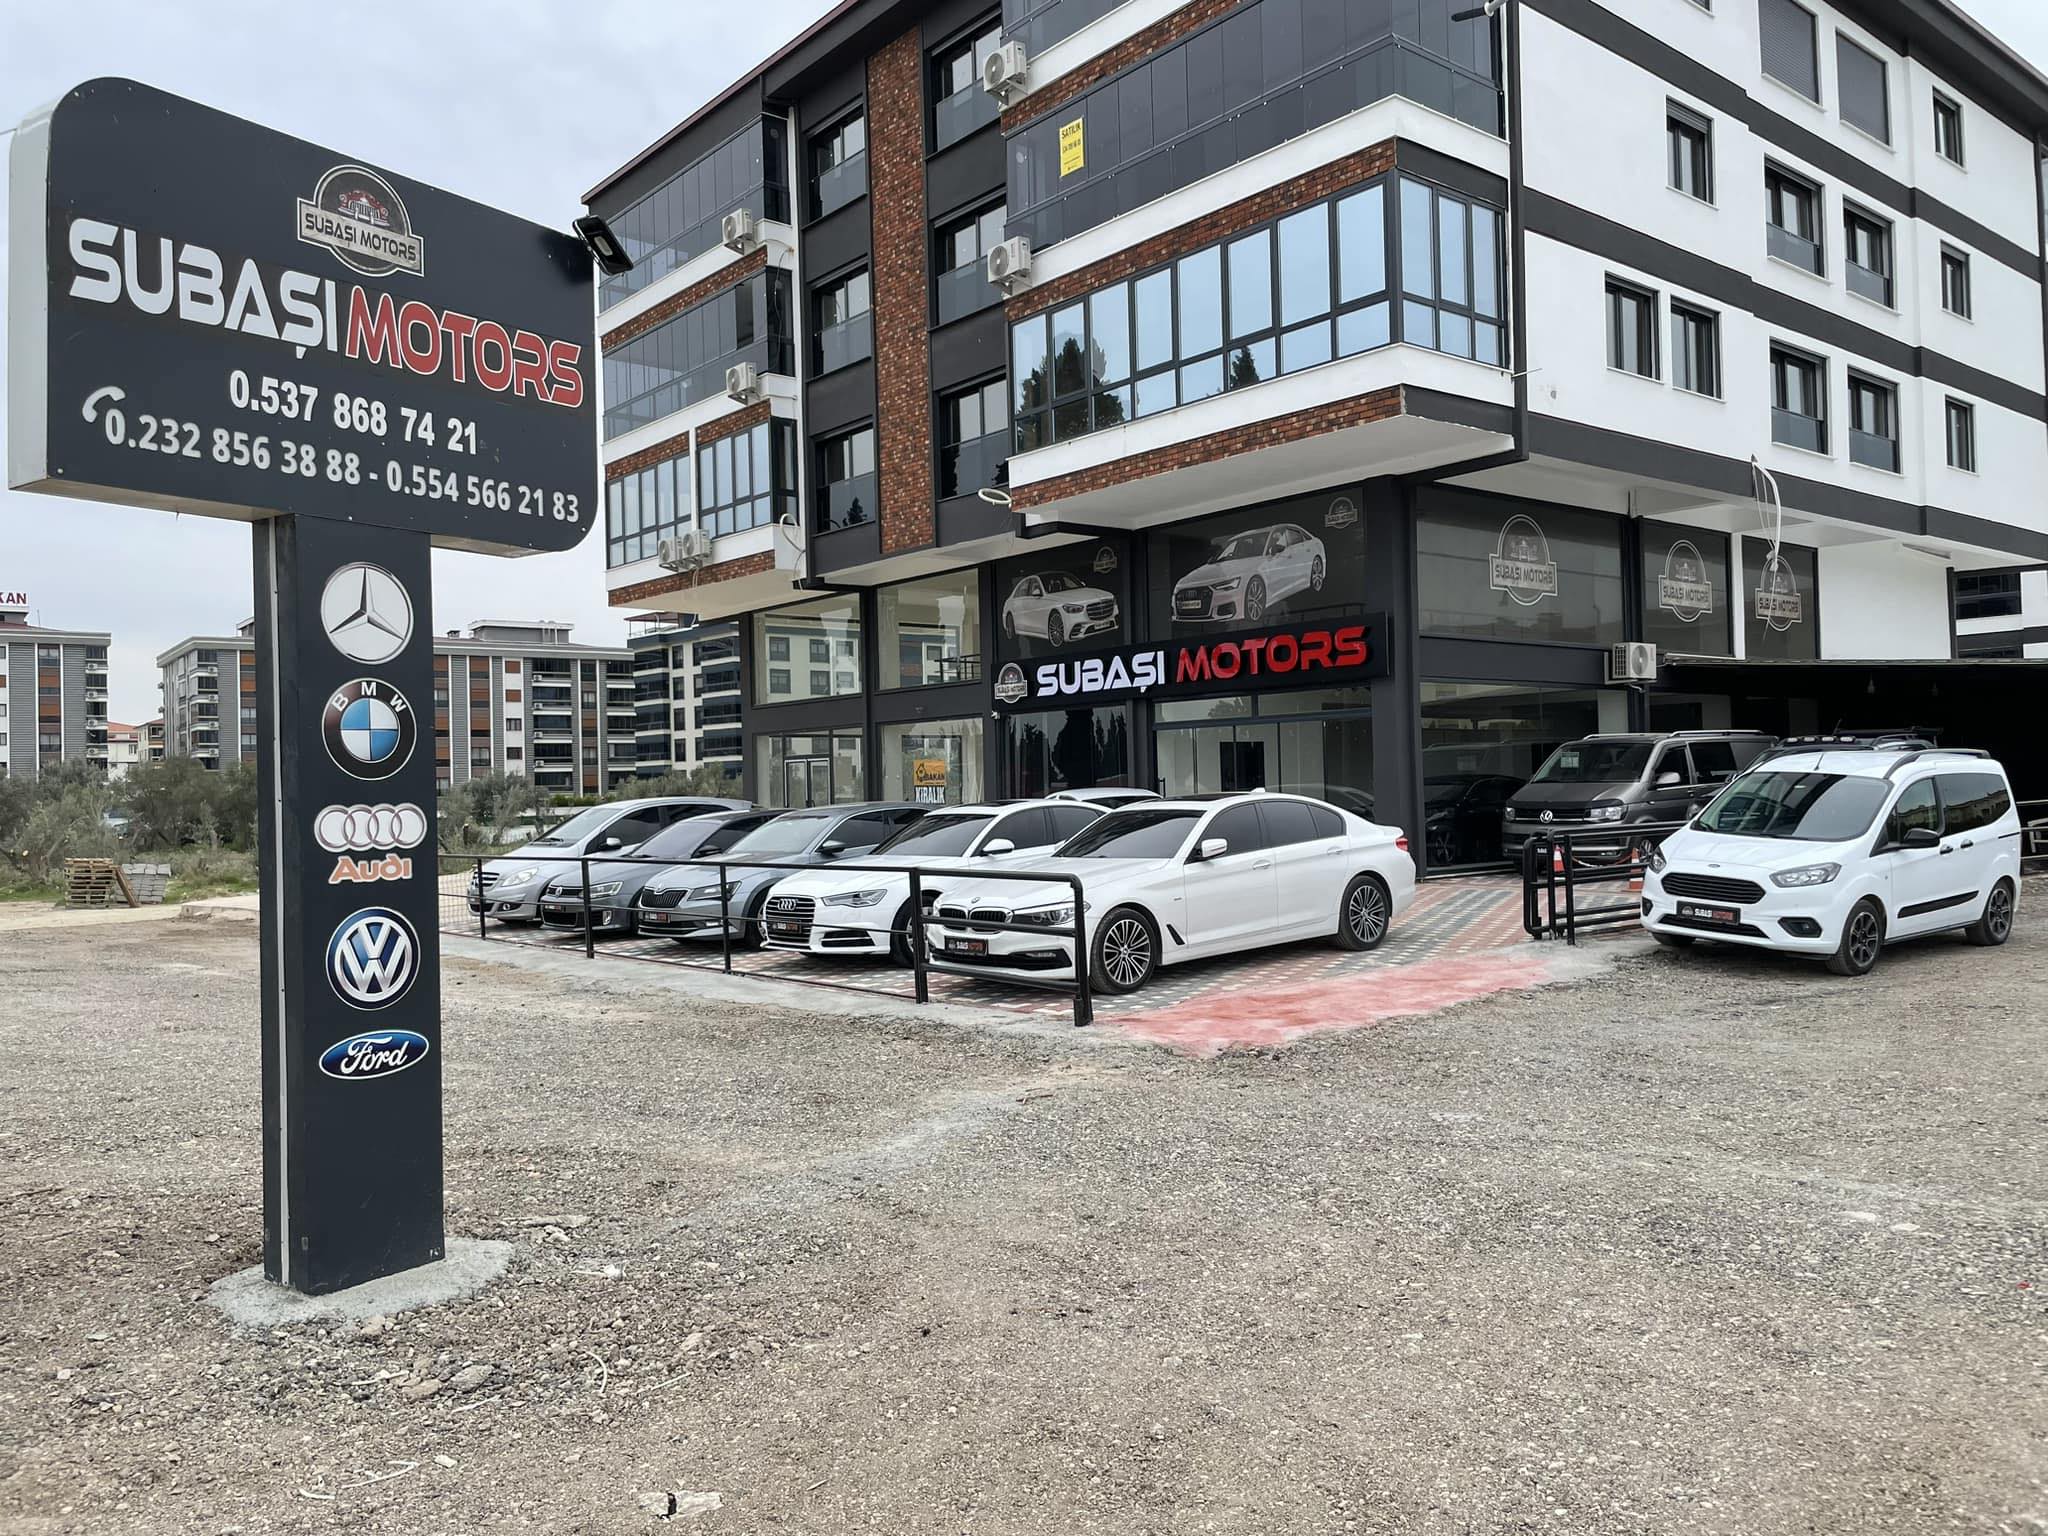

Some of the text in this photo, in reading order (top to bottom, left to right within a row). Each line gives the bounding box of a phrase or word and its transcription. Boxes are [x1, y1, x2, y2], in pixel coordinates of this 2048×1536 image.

[360, 229, 417, 262] MOTORS
[68, 217, 584, 409] SUBAŞI MOTORS
[229, 369, 477, 456] 0.537 868 74 21
[104, 407, 202, 459] 0.232
[212, 427, 271, 470] 856
[280, 439, 318, 478] 38
[325, 448, 361, 486] 88
[386, 459, 460, 503] 0.554
[466, 474, 512, 512] 566
[518, 484, 544, 518] 21
[552, 491, 580, 524] 83
[1523, 567, 1553, 585] MOTORS
[1036, 625, 1368, 694] SUBAŞI MOTORS
[331, 681, 408, 713] BMW
[915, 785, 945, 803] KIRALIK
[328, 854, 413, 884] Audi
[340, 1035, 410, 1074] Ford
